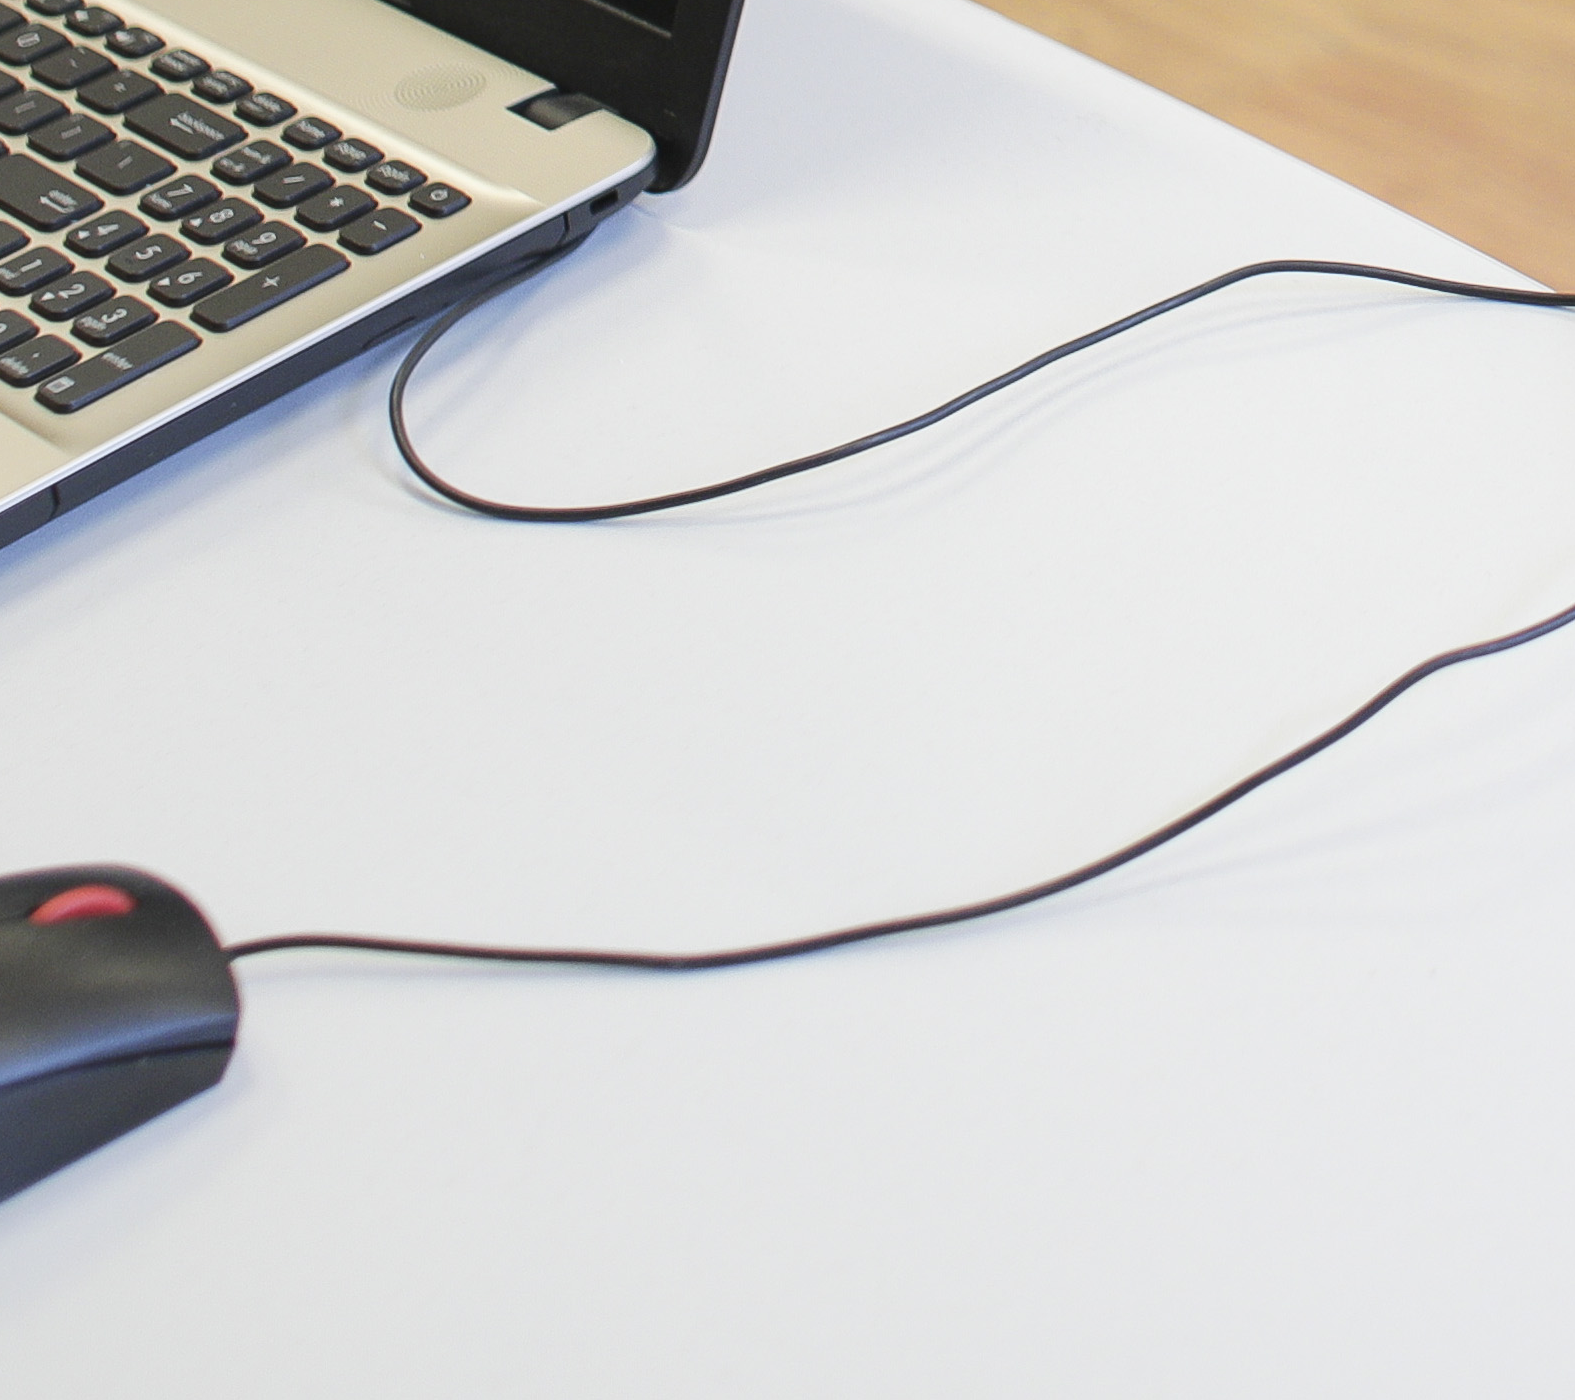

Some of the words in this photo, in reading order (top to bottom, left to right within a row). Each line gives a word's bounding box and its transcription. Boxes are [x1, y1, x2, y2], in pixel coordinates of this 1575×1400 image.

[167, 183, 193, 197] 7
[209, 208, 233, 222] 8
[97, 223, 118, 235] 4
[251, 231, 276, 244] 9
[135, 245, 161, 259] 5
[19, 258, 42, 272] 1
[177, 271, 202, 284] 6
[57, 283, 84, 298] 2
[100, 308, 127, 323] 3
